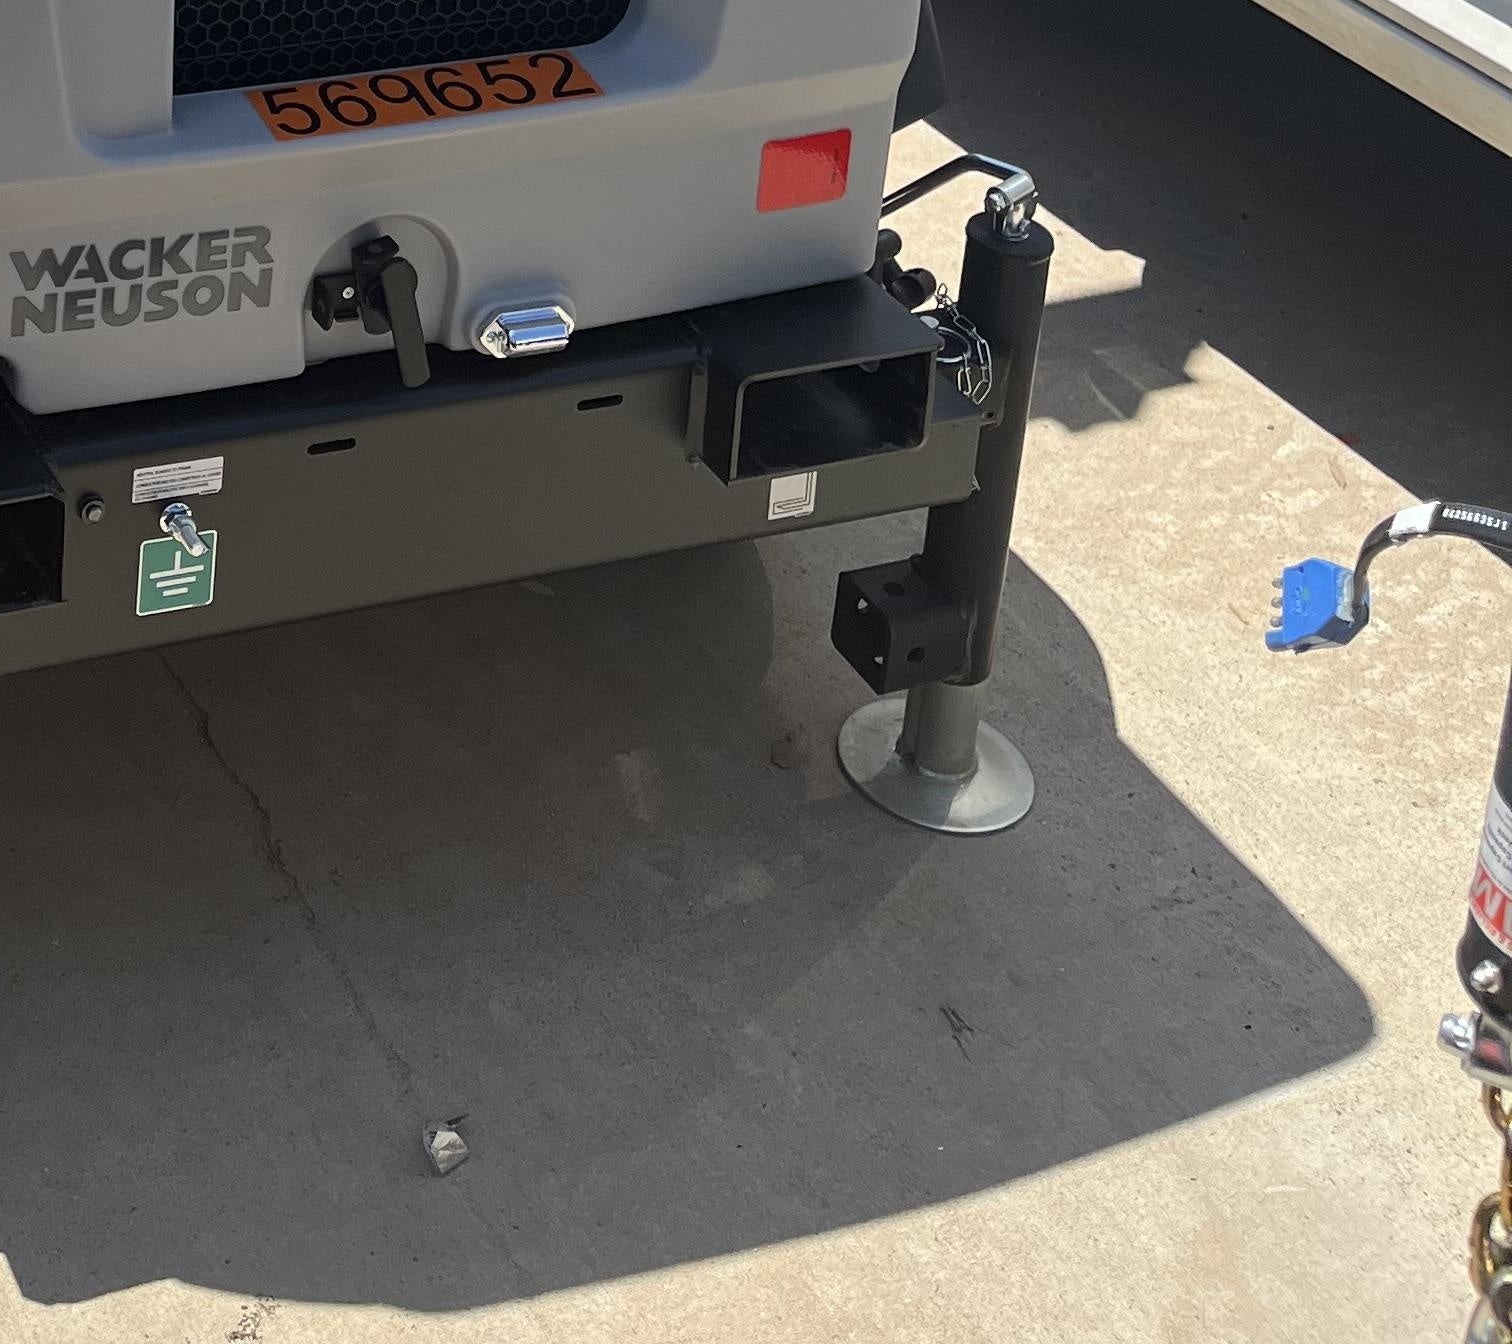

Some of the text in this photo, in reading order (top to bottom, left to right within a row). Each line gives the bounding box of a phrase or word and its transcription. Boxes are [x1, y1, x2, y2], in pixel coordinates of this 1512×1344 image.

[261, 53, 596, 136] 569652
[9, 225, 275, 291] WACKER
[10, 268, 274, 338] NEUSON
